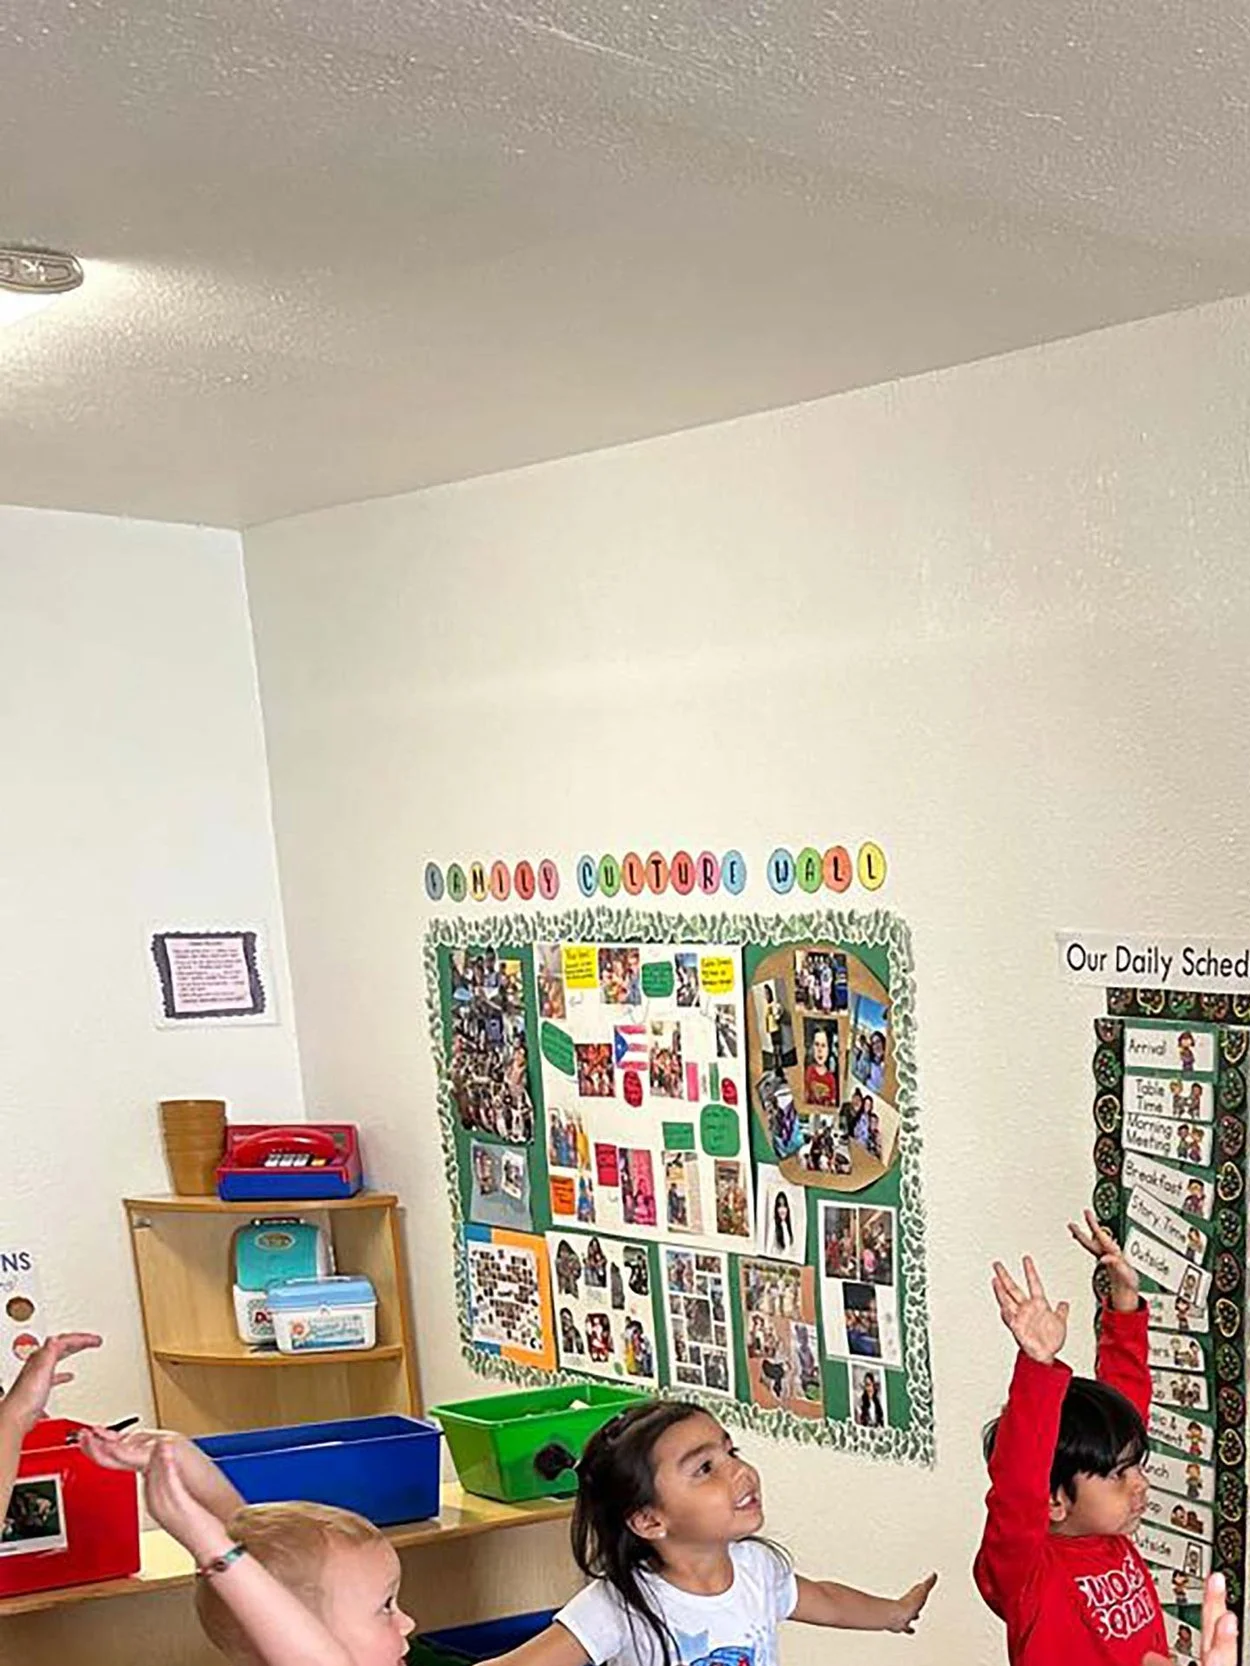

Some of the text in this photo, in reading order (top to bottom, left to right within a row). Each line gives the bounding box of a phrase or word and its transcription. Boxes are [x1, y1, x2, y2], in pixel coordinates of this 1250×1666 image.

[426, 844, 884, 899] FAMILY CULTURE WALL
[1066, 943, 1107, 972] Our
[1115, 945, 1174, 982] Daily
[1128, 1039, 1166, 1055] Arrival
[1136, 1078, 1165, 1098] Table
[1136, 1095, 1163, 1113] Time
[1126, 1130, 1171, 1152] Meeting
[1127, 1112, 1173, 1140] Morning
[1125, 1161, 1184, 1197] Breakfast
[1131, 1195, 1186, 1243] Story Time
[1131, 1240, 1169, 1275] Outside
